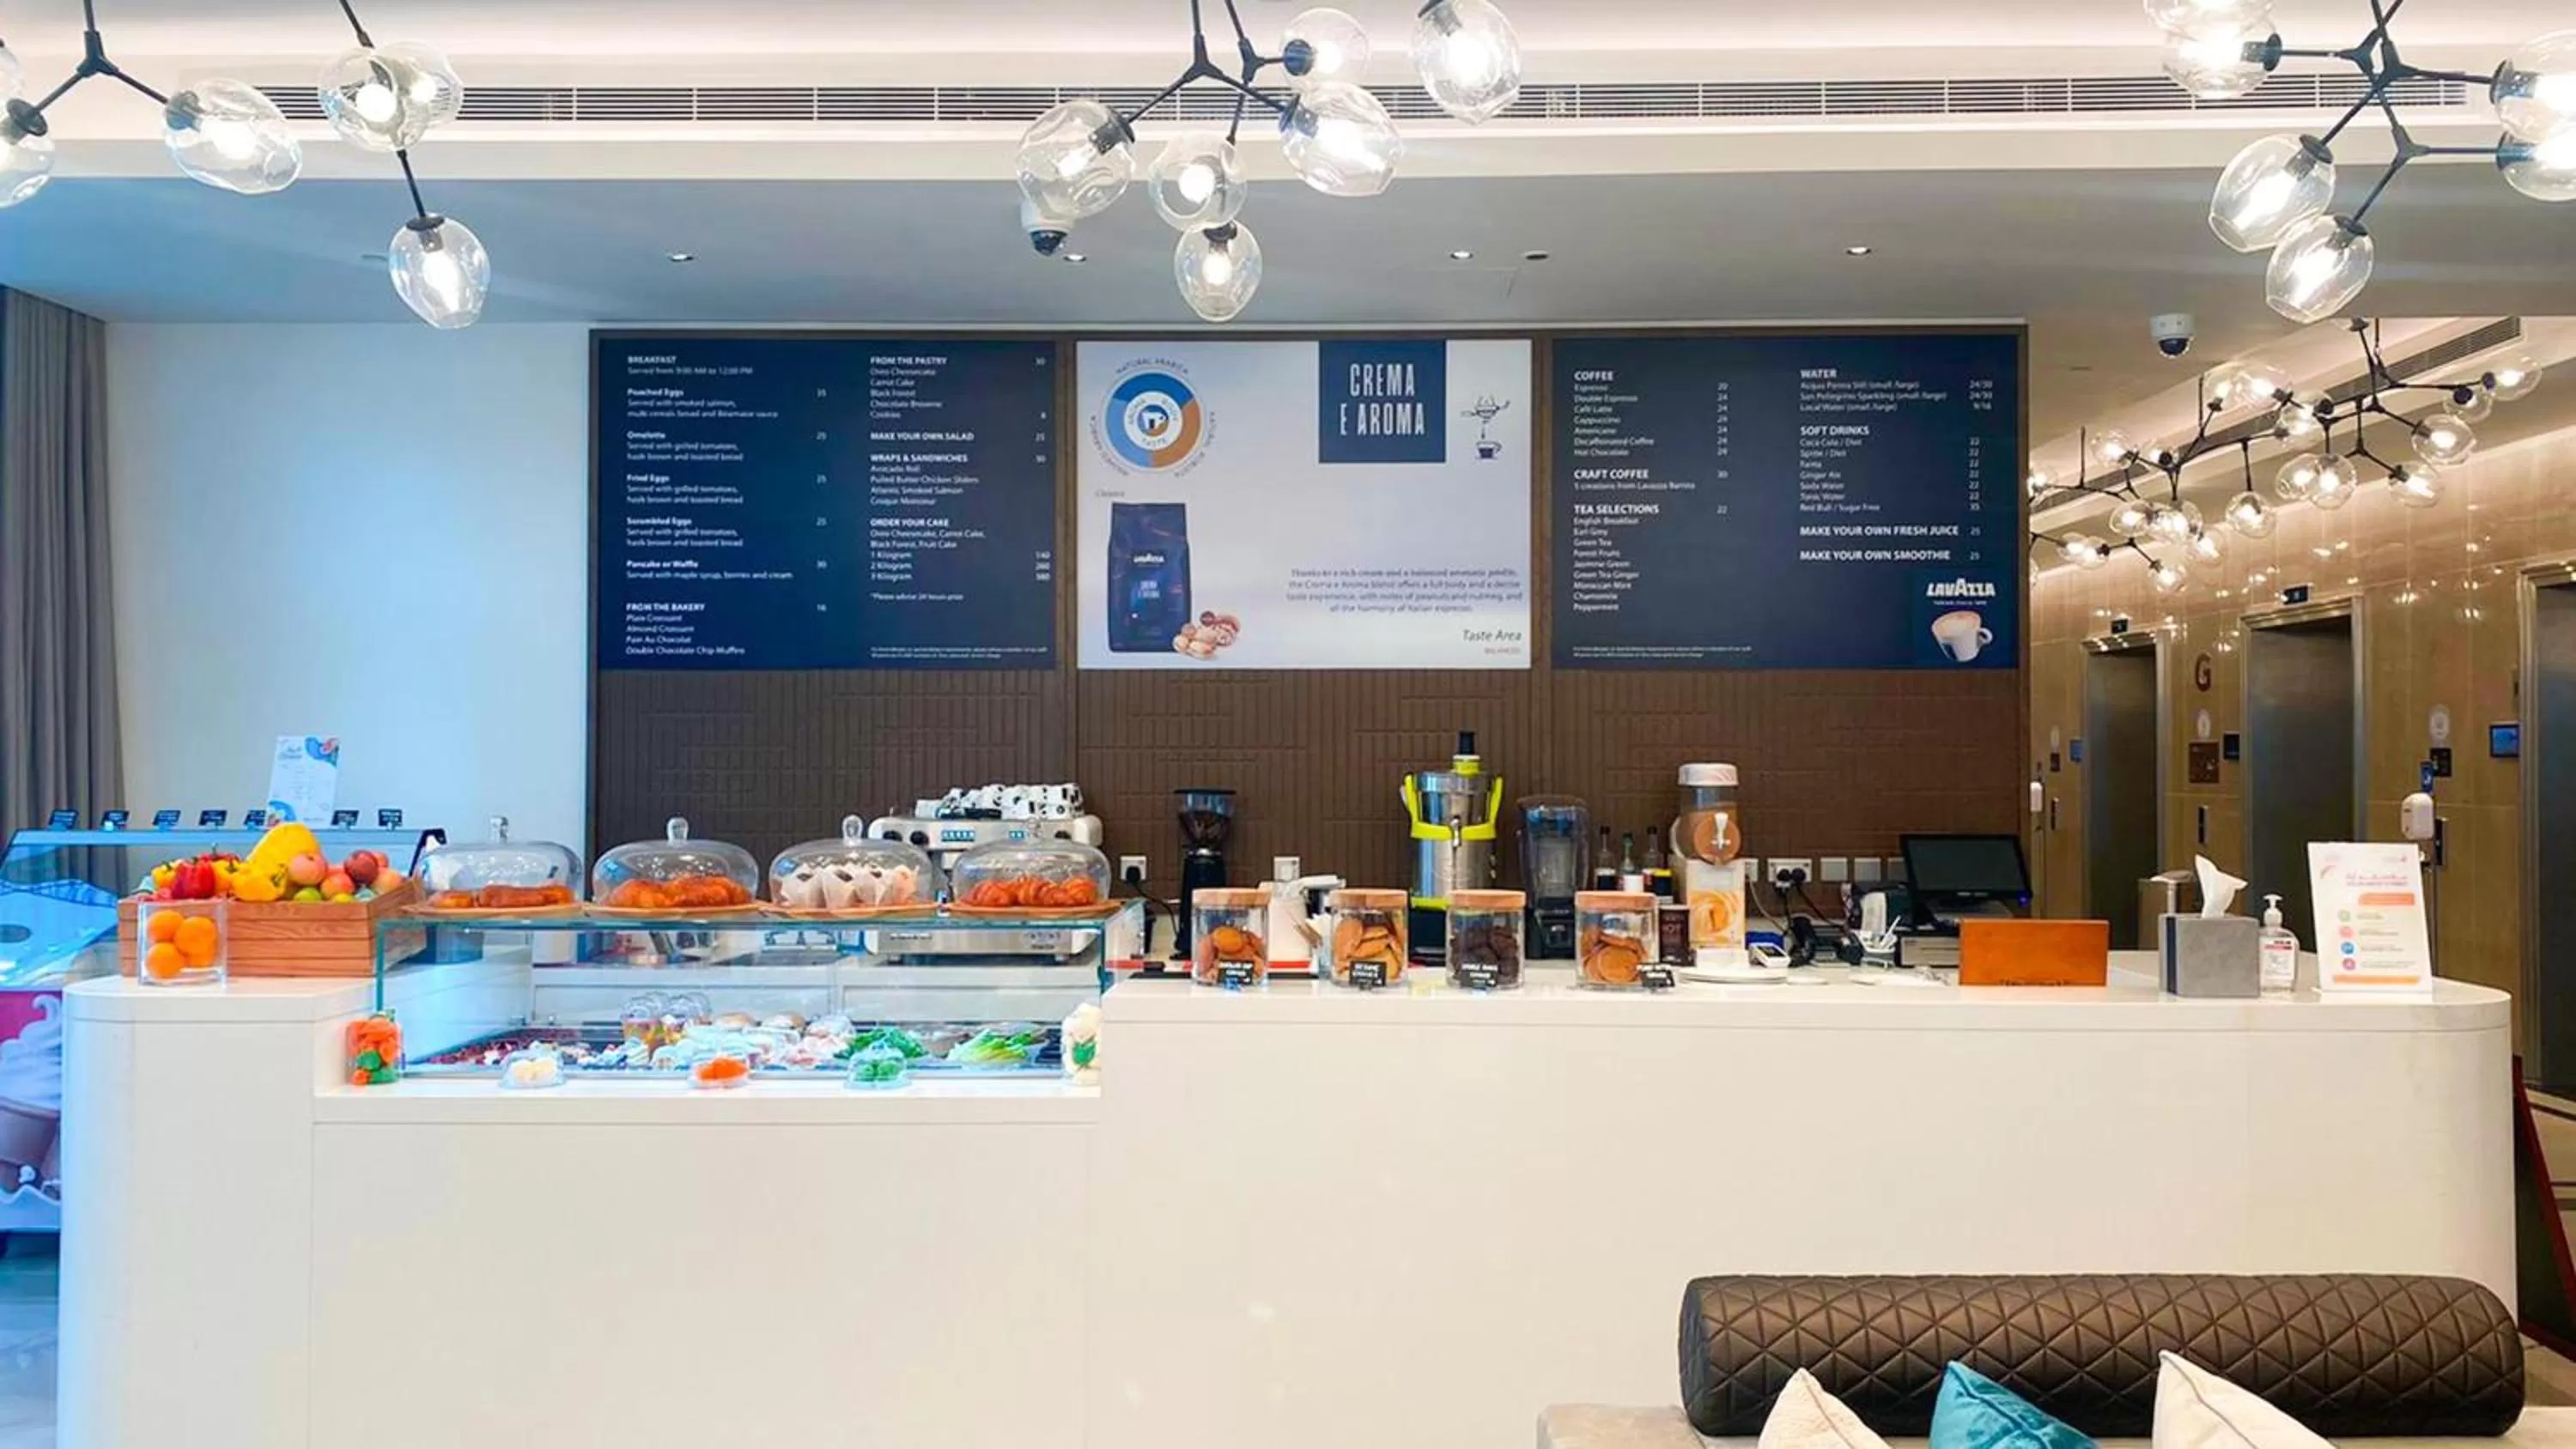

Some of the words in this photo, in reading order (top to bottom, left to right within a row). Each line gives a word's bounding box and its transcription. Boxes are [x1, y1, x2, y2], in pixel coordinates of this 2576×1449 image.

[628, 355, 676, 364] BREAKFAST
[871, 356, 895, 365] FROM
[896, 356, 913, 365] THE
[914, 356, 946, 365] PASTRY
[1575, 372, 1613, 380] COFFEE
[1801, 370, 1837, 379] WATER
[1350, 364, 1415, 397] CREMA
[664, 388, 683, 397] Eggs
[1340, 403, 1347, 435] E
[1358, 403, 1425, 435] AROMA
[1801, 426, 1827, 434] SOFT
[1829, 426, 1868, 434] DRINKS
[871, 432, 895, 440] MAKE
[896, 432, 920, 440] YOUR
[922, 432, 943, 440] OWN
[945, 432, 974, 440] SALAD
[871, 454, 901, 463] WRAPS
[910, 454, 968, 463] SANDWICHES
[649, 474, 669, 483] Eggs
[1575, 470, 1607, 478] CRAFT
[1609, 470, 1649, 478] COFFEE
[1575, 505, 1594, 513] TEA
[1595, 505, 1659, 513] SELECTIONS
[671, 517, 691, 526] Eggs
[871, 518, 900, 527] ORDER
[902, 518, 924, 527] YOUR
[926, 518, 949, 527] CAKE
[1574, 517, 1601, 526] English
[1800, 526, 1831, 535] MAKE
[1832, 526, 1862, 535] YOUR
[1864, 526, 1891, 535] OWN
[1893, 526, 1927, 535] FRESH
[1929, 526, 1958, 535] JUICE
[877, 550, 912, 560] Kilogram
[1800, 551, 1831, 560] MAKE
[1832, 551, 1862, 560] YOUR
[1864, 551, 1891, 560] OWN
[1893, 551, 1949, 560] SMOOTHIE
[877, 561, 912, 571] Kilogram
[877, 572, 912, 581] Kilogram
[1926, 578, 1996, 597] LAVAZZA
[626, 603, 652, 611] FROM
[653, 603, 669, 611] THE
[671, 603, 704, 611] BAKERY
[1463, 629, 1492, 642] Taste
[1495, 629, 1522, 642] Area
[2195, 653, 2212, 692] G
